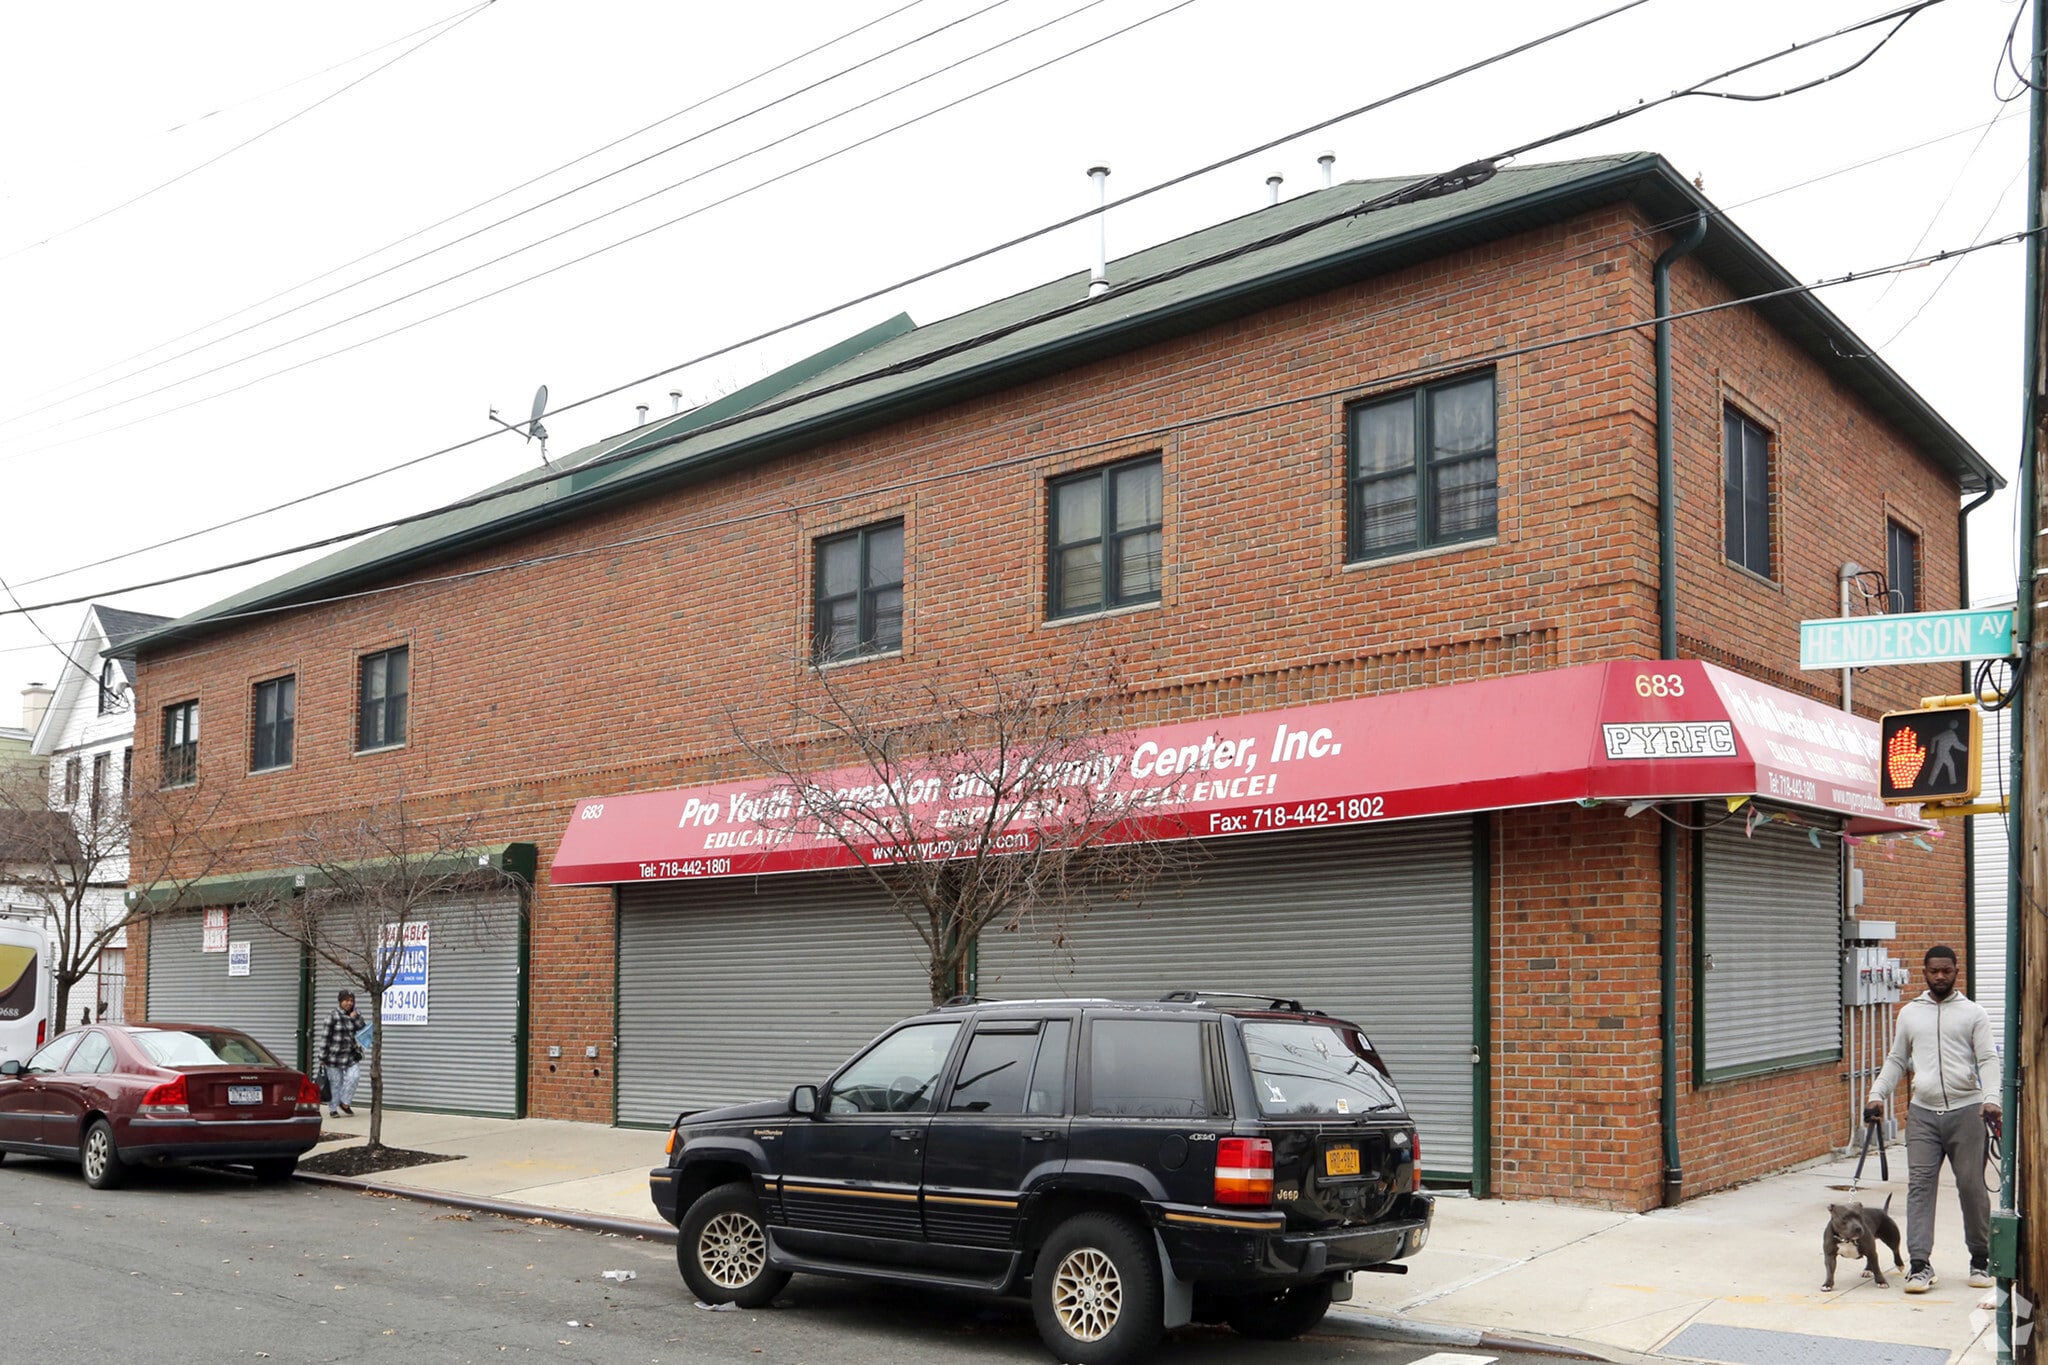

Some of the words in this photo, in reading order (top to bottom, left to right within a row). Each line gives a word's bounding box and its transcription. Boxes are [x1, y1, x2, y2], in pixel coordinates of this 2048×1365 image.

[1807, 617, 1971, 662] HENDERSON
[1635, 674, 1685, 697] 683
[1607, 725, 1732, 755] PYRFC
[678, 798, 719, 828] Pro
[726, 788, 794, 824] Youth
[949, 760, 1009, 800] and
[1013, 750, 1121, 791] Family
[1129, 734, 1257, 779] Center,
[1270, 724, 1342, 762] Inc.
[581, 804, 604, 820] 683
[1209, 813, 1248, 833] Fax:
[1252, 796, 1384, 828] 718-442-1802
[872, 831, 1029, 860] www.myproyout.com
[639, 863, 657, 878] Tel:
[659, 858, 731, 877] 718-442-1801
[380, 925, 429, 942] AVAABLE
[383, 990, 426, 1009] 79-3400
[1277, 1189, 1299, 1201] Jeep
